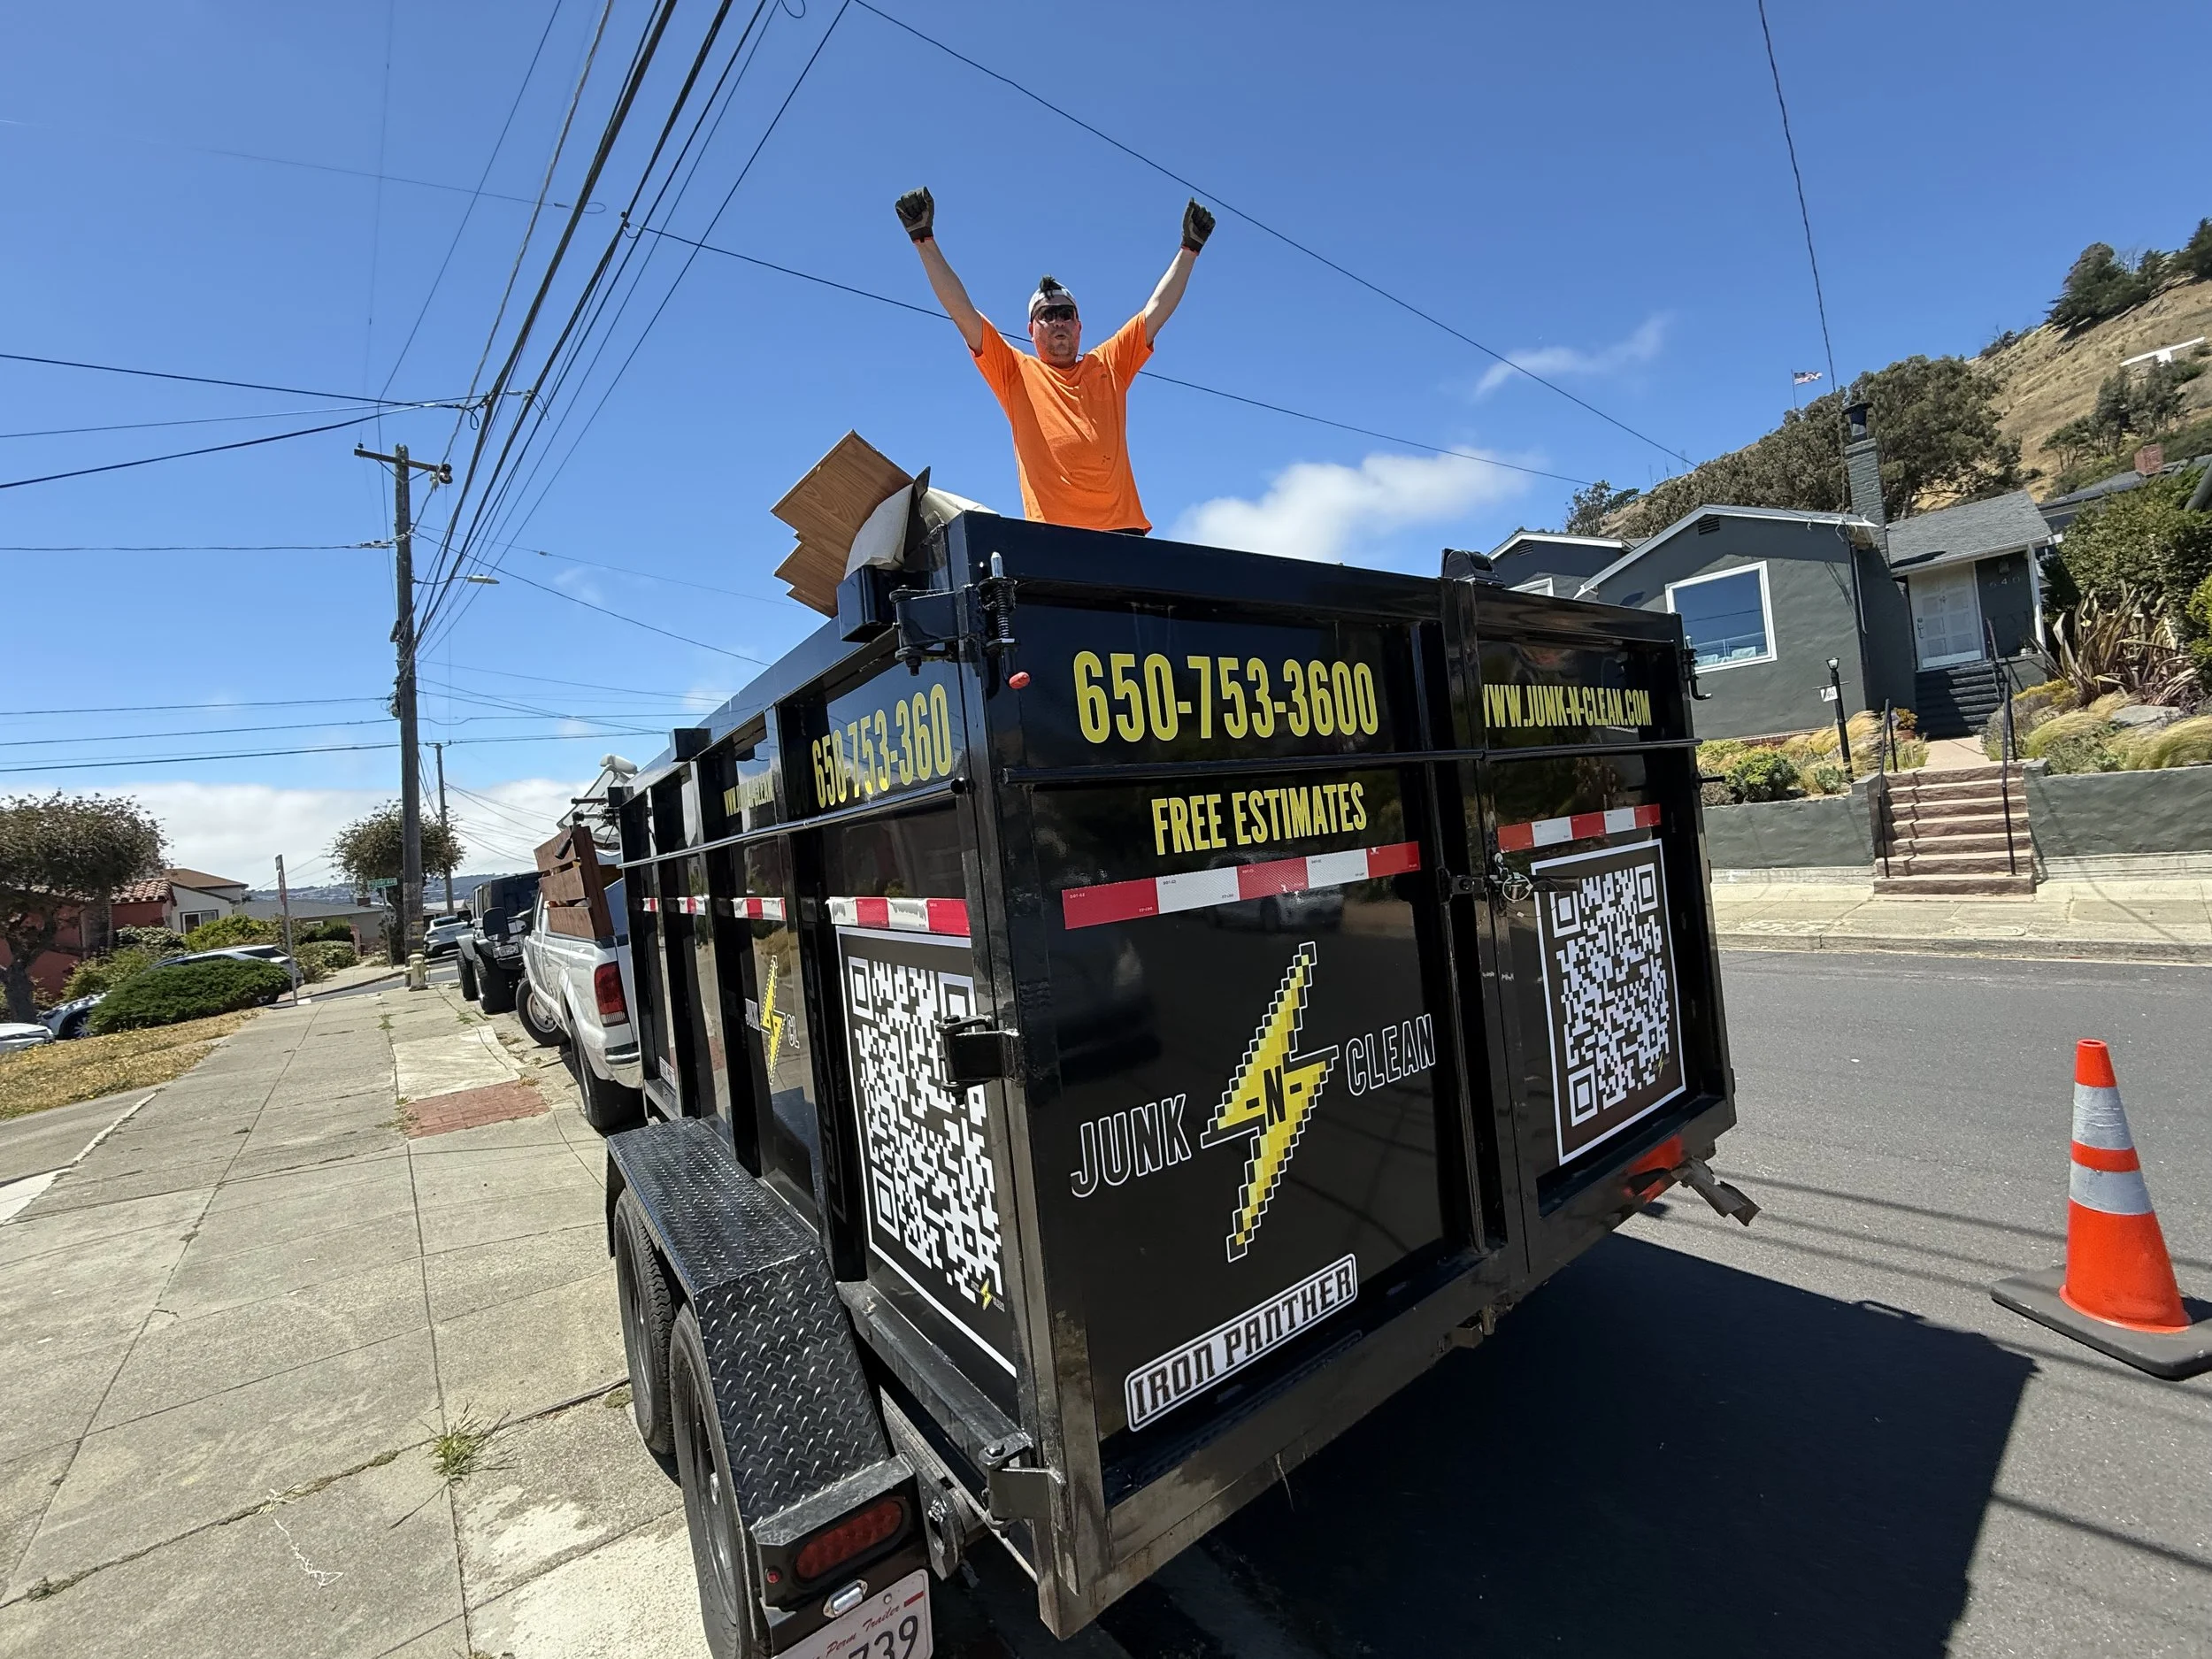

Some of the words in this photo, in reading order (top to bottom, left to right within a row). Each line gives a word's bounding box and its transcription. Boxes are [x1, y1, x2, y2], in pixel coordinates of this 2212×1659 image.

[811, 683, 952, 809] 650-753-360
[1073, 650, 1379, 744] 650-753-3600
[1151, 794, 1226, 856] FREE
[1232, 782, 1367, 846] ESTIMATES
[1071, 1094, 1192, 1197] JUNK
[1345, 1013, 1436, 1096] CLEAN
[1133, 1340, 1216, 1418] IRON
[1223, 1263, 1353, 1368] PANTHER
[826, 1632, 857, 1659] Perm
[863, 1605, 901, 1632] Trailer
